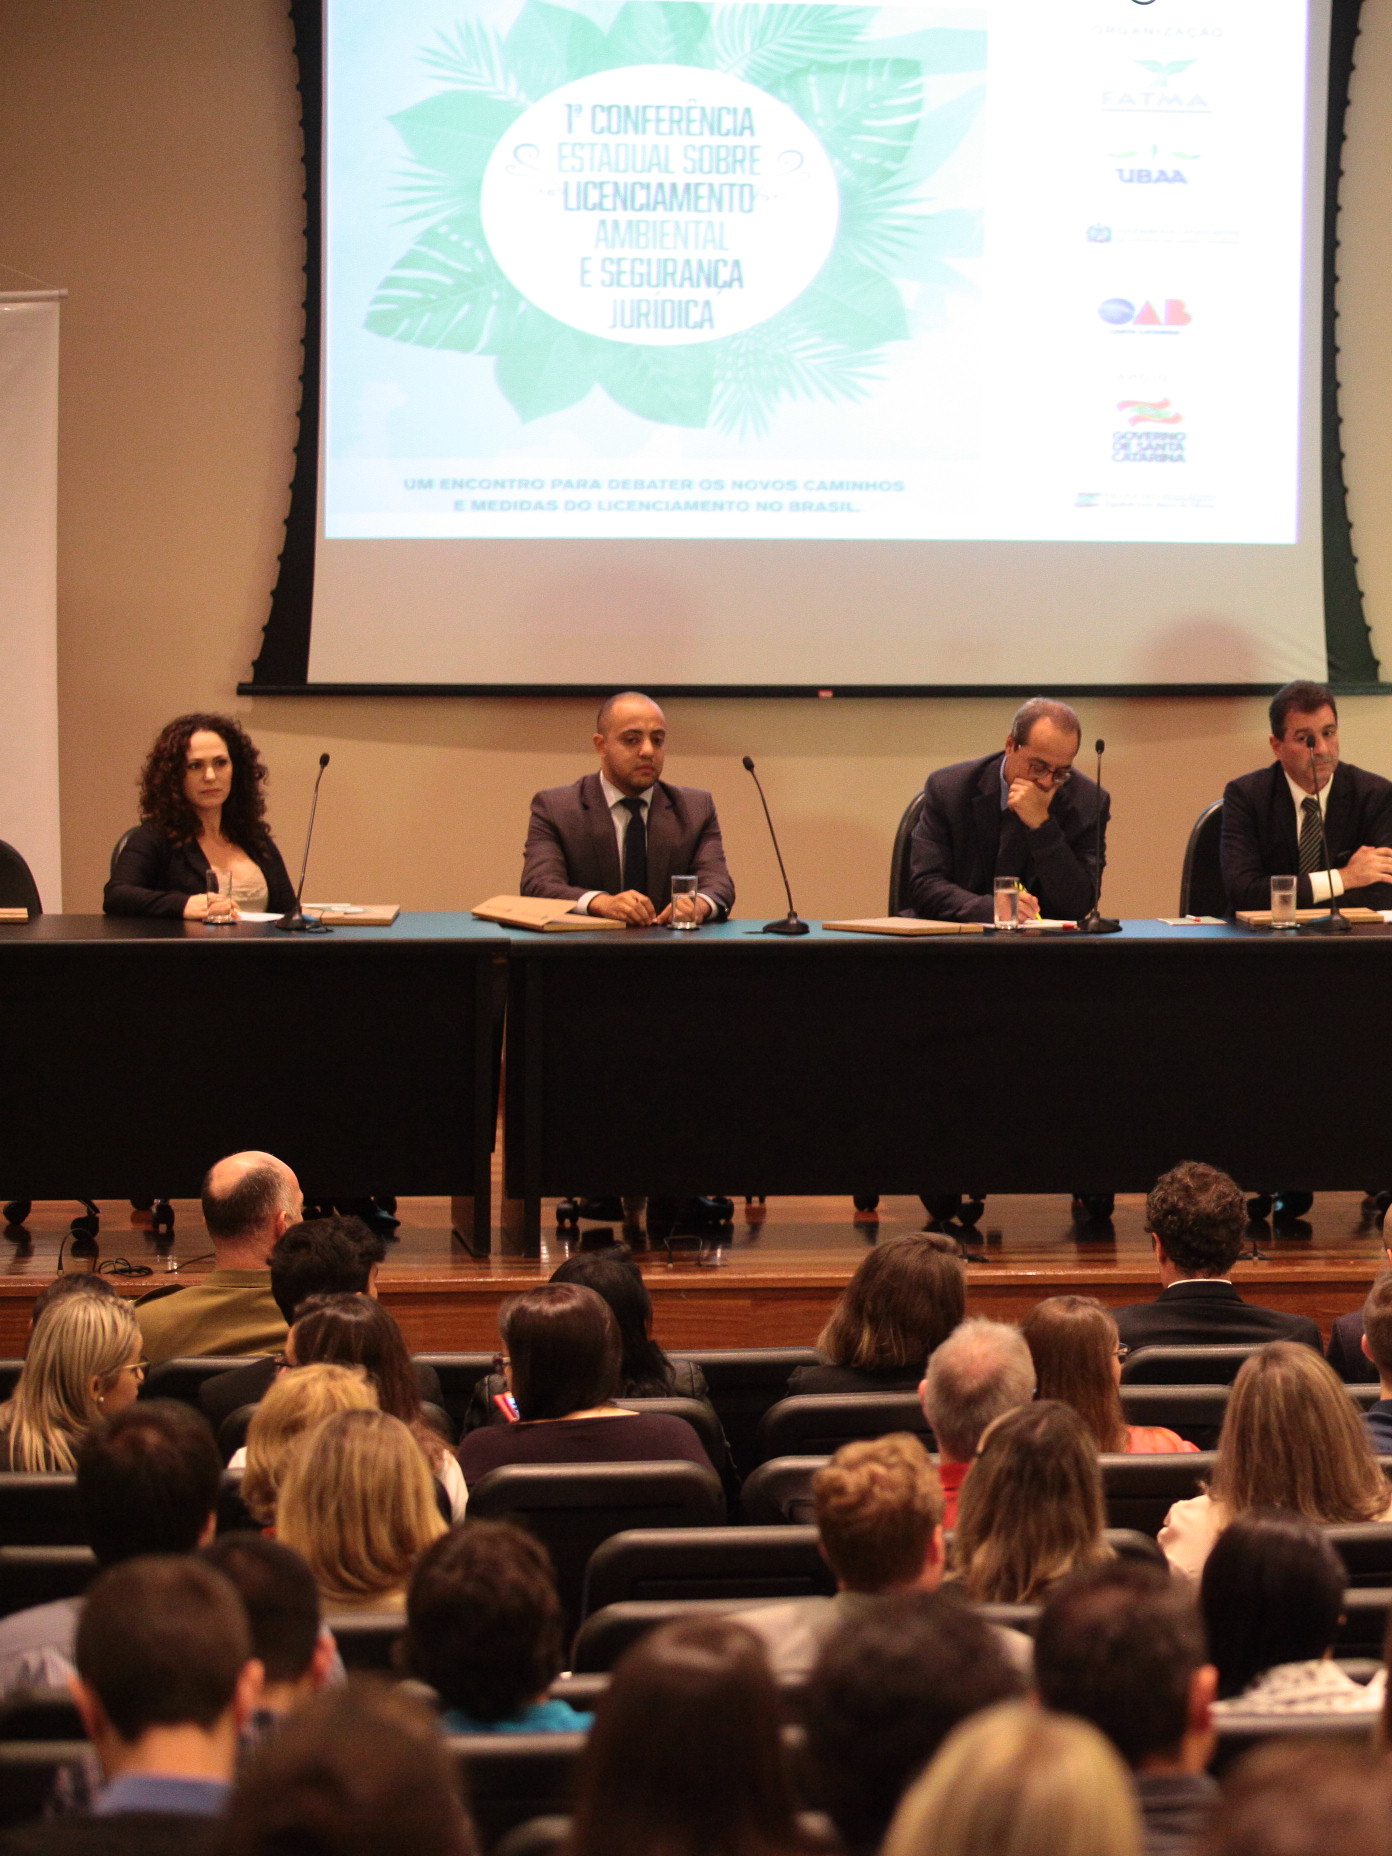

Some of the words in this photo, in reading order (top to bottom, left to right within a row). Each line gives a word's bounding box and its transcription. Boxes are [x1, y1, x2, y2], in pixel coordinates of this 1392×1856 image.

[1101, 91, 1209, 107] FATMA
[591, 98, 756, 137] CONFERÊNCIA
[558, 142, 675, 174] ESTADUAL
[683, 144, 762, 175] SOBRE
[1115, 168, 1188, 184] UBAA
[563, 181, 755, 213] LICENCIAMENTO
[594, 219, 730, 251] AMBIENTAL
[580, 257, 592, 288] E
[600, 257, 744, 295] SEGURANÇA
[608, 291, 715, 329] JURÍDICA
[403, 478, 435, 490] UM
[440, 478, 545, 490] ENCONTRO
[550, 478, 601, 490] PARA
[607, 478, 693, 490] DEBATER
[698, 479, 725, 490] OS
[731, 479, 798, 491] NOVOS
[803, 480, 905, 492] CAMINHOS
[453, 499, 465, 511] E
[470, 499, 559, 511] MEDIDAS
[564, 499, 592, 511] DO
[597, 499, 750, 511] LICENCIAMENTO
[755, 500, 783, 511] NO
